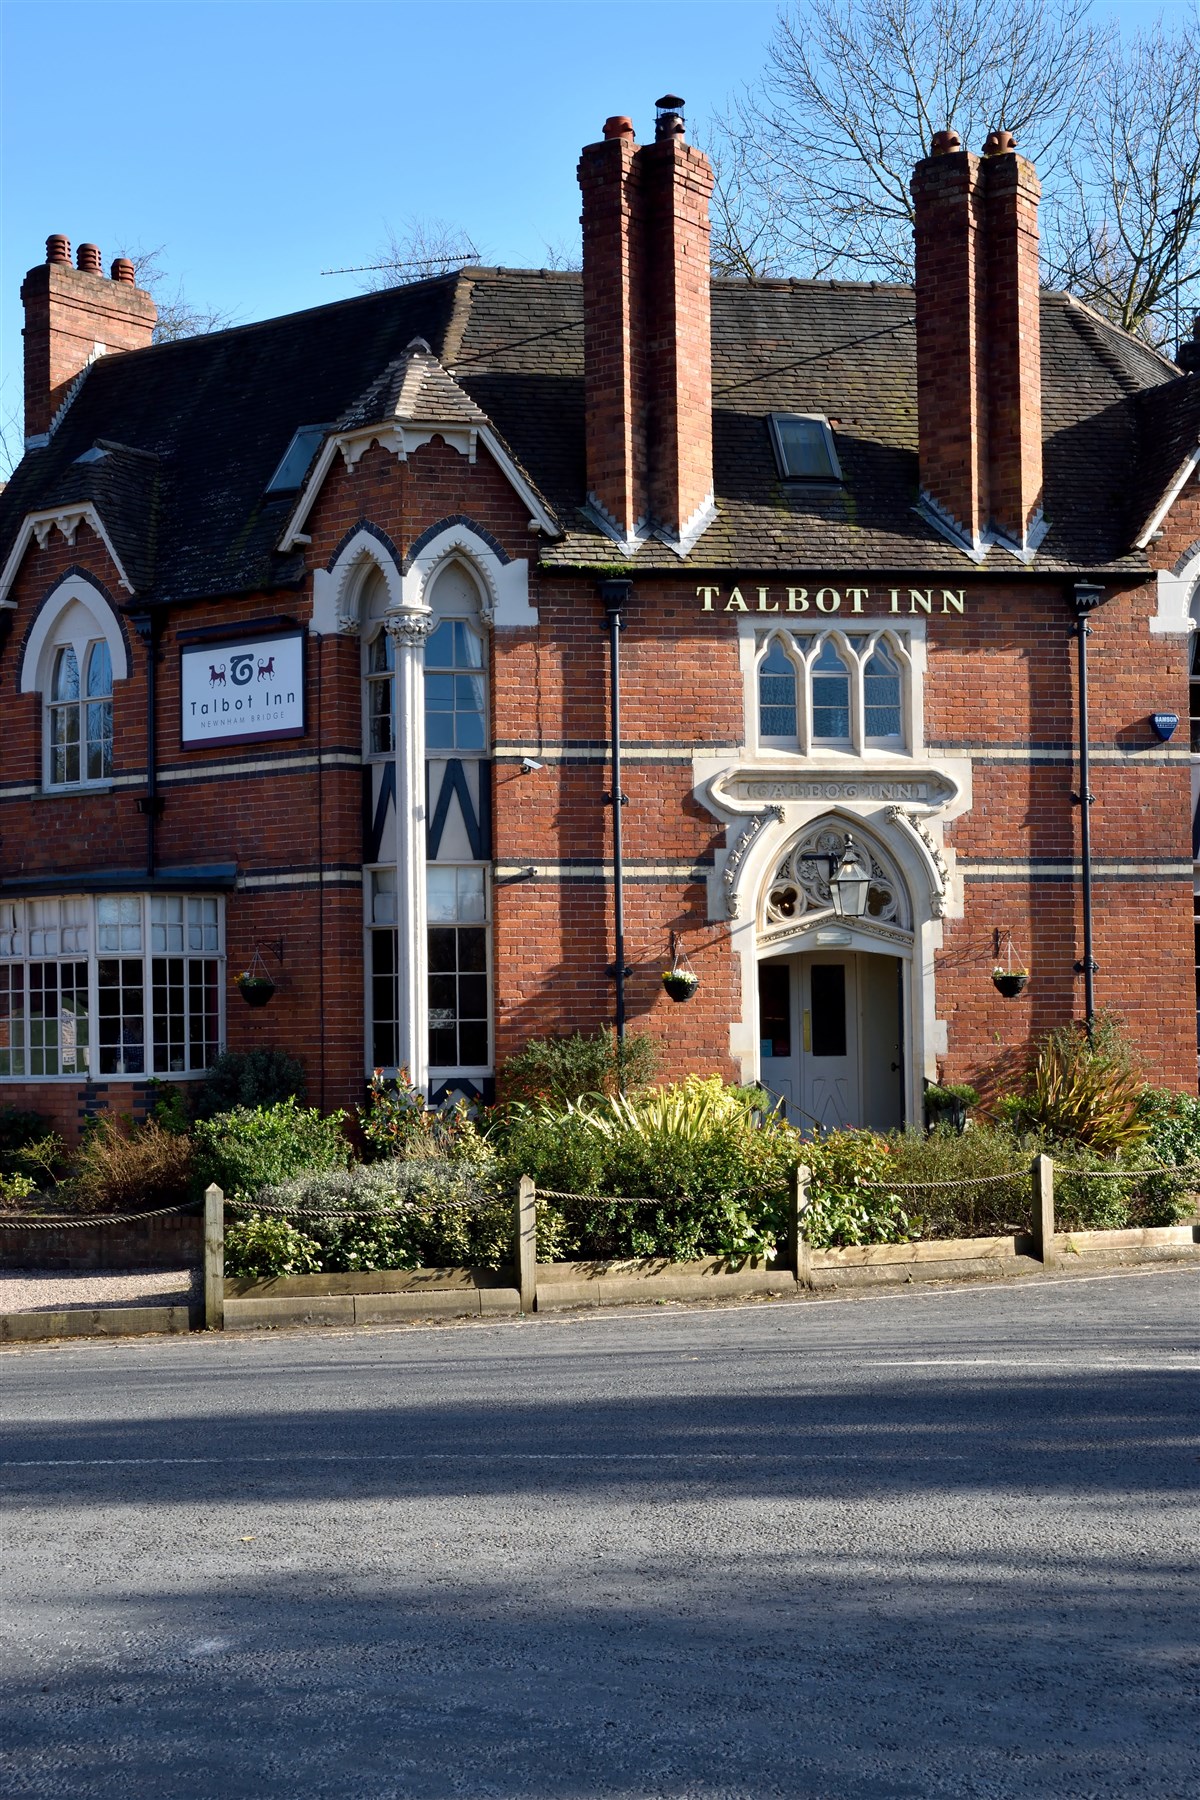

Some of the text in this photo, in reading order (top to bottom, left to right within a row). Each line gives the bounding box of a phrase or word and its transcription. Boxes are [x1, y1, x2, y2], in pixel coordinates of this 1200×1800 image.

[696, 586, 967, 614] TALBOT INN
[190, 691, 295, 716] Talbot Inn
[200, 711, 285, 728] NEWNHAM BRIDGE
[867, 783, 913, 799] INN
